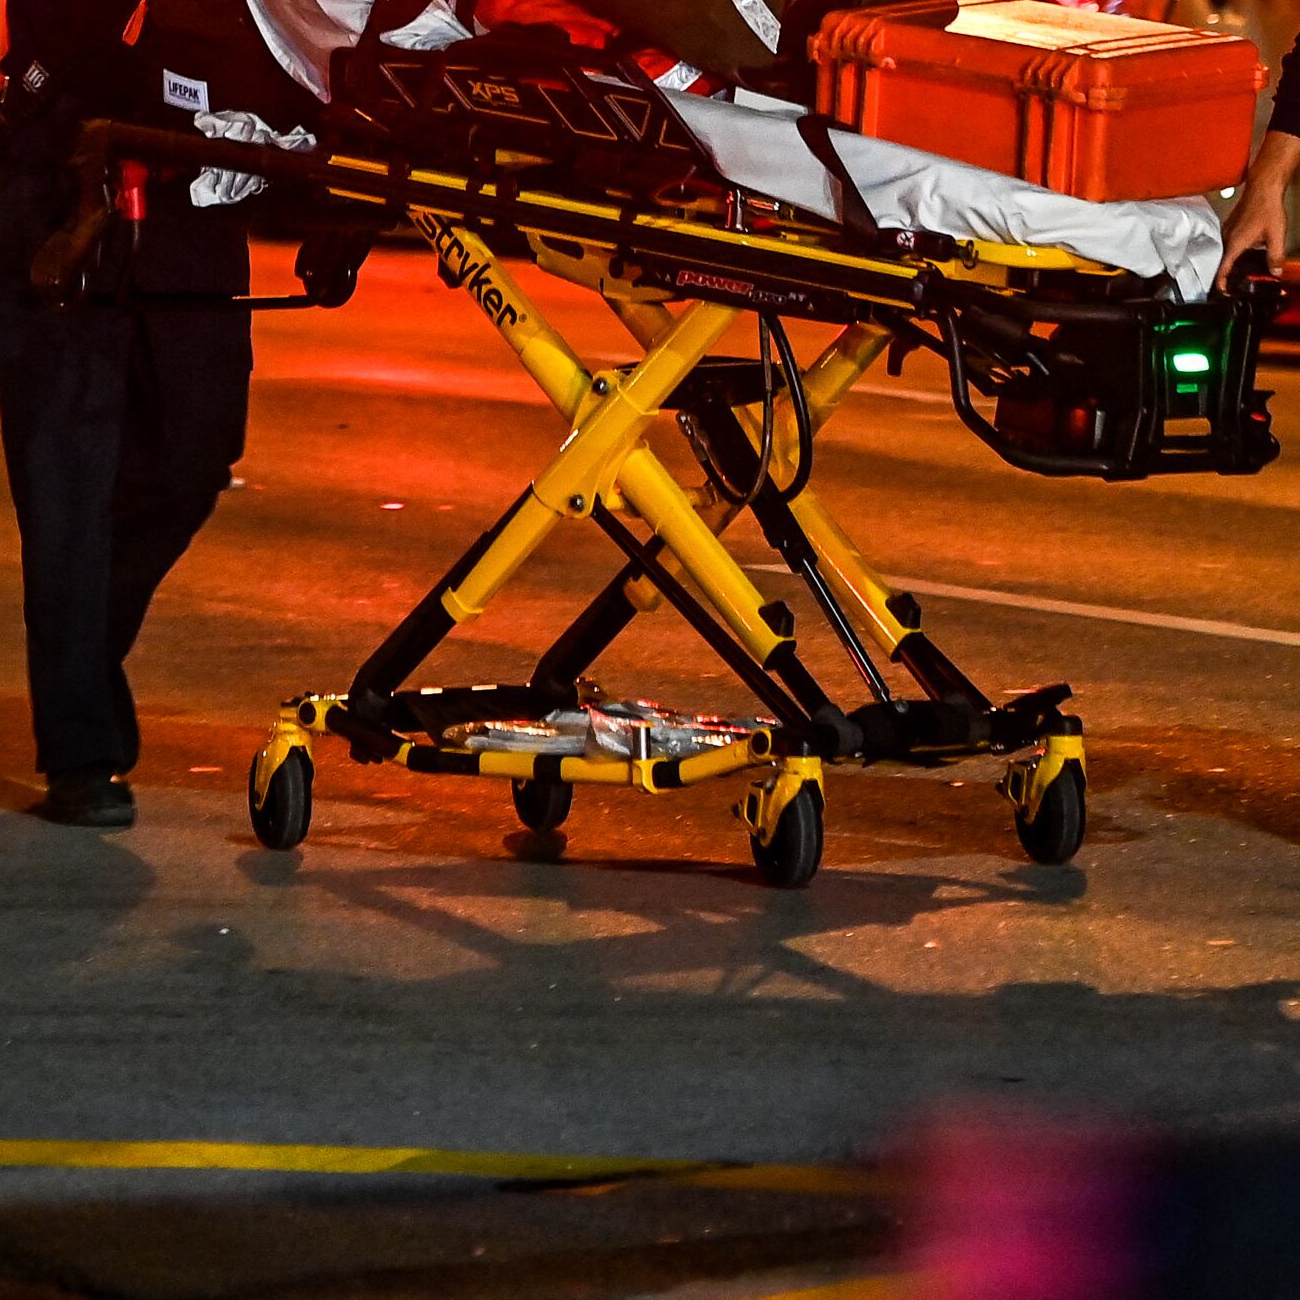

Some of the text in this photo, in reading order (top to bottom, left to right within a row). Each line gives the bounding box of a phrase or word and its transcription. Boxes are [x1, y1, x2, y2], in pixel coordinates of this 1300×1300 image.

[168, 80, 200, 101] LIFEPAK
[467, 80, 520, 103] XPS
[413, 211, 518, 327] stryker
